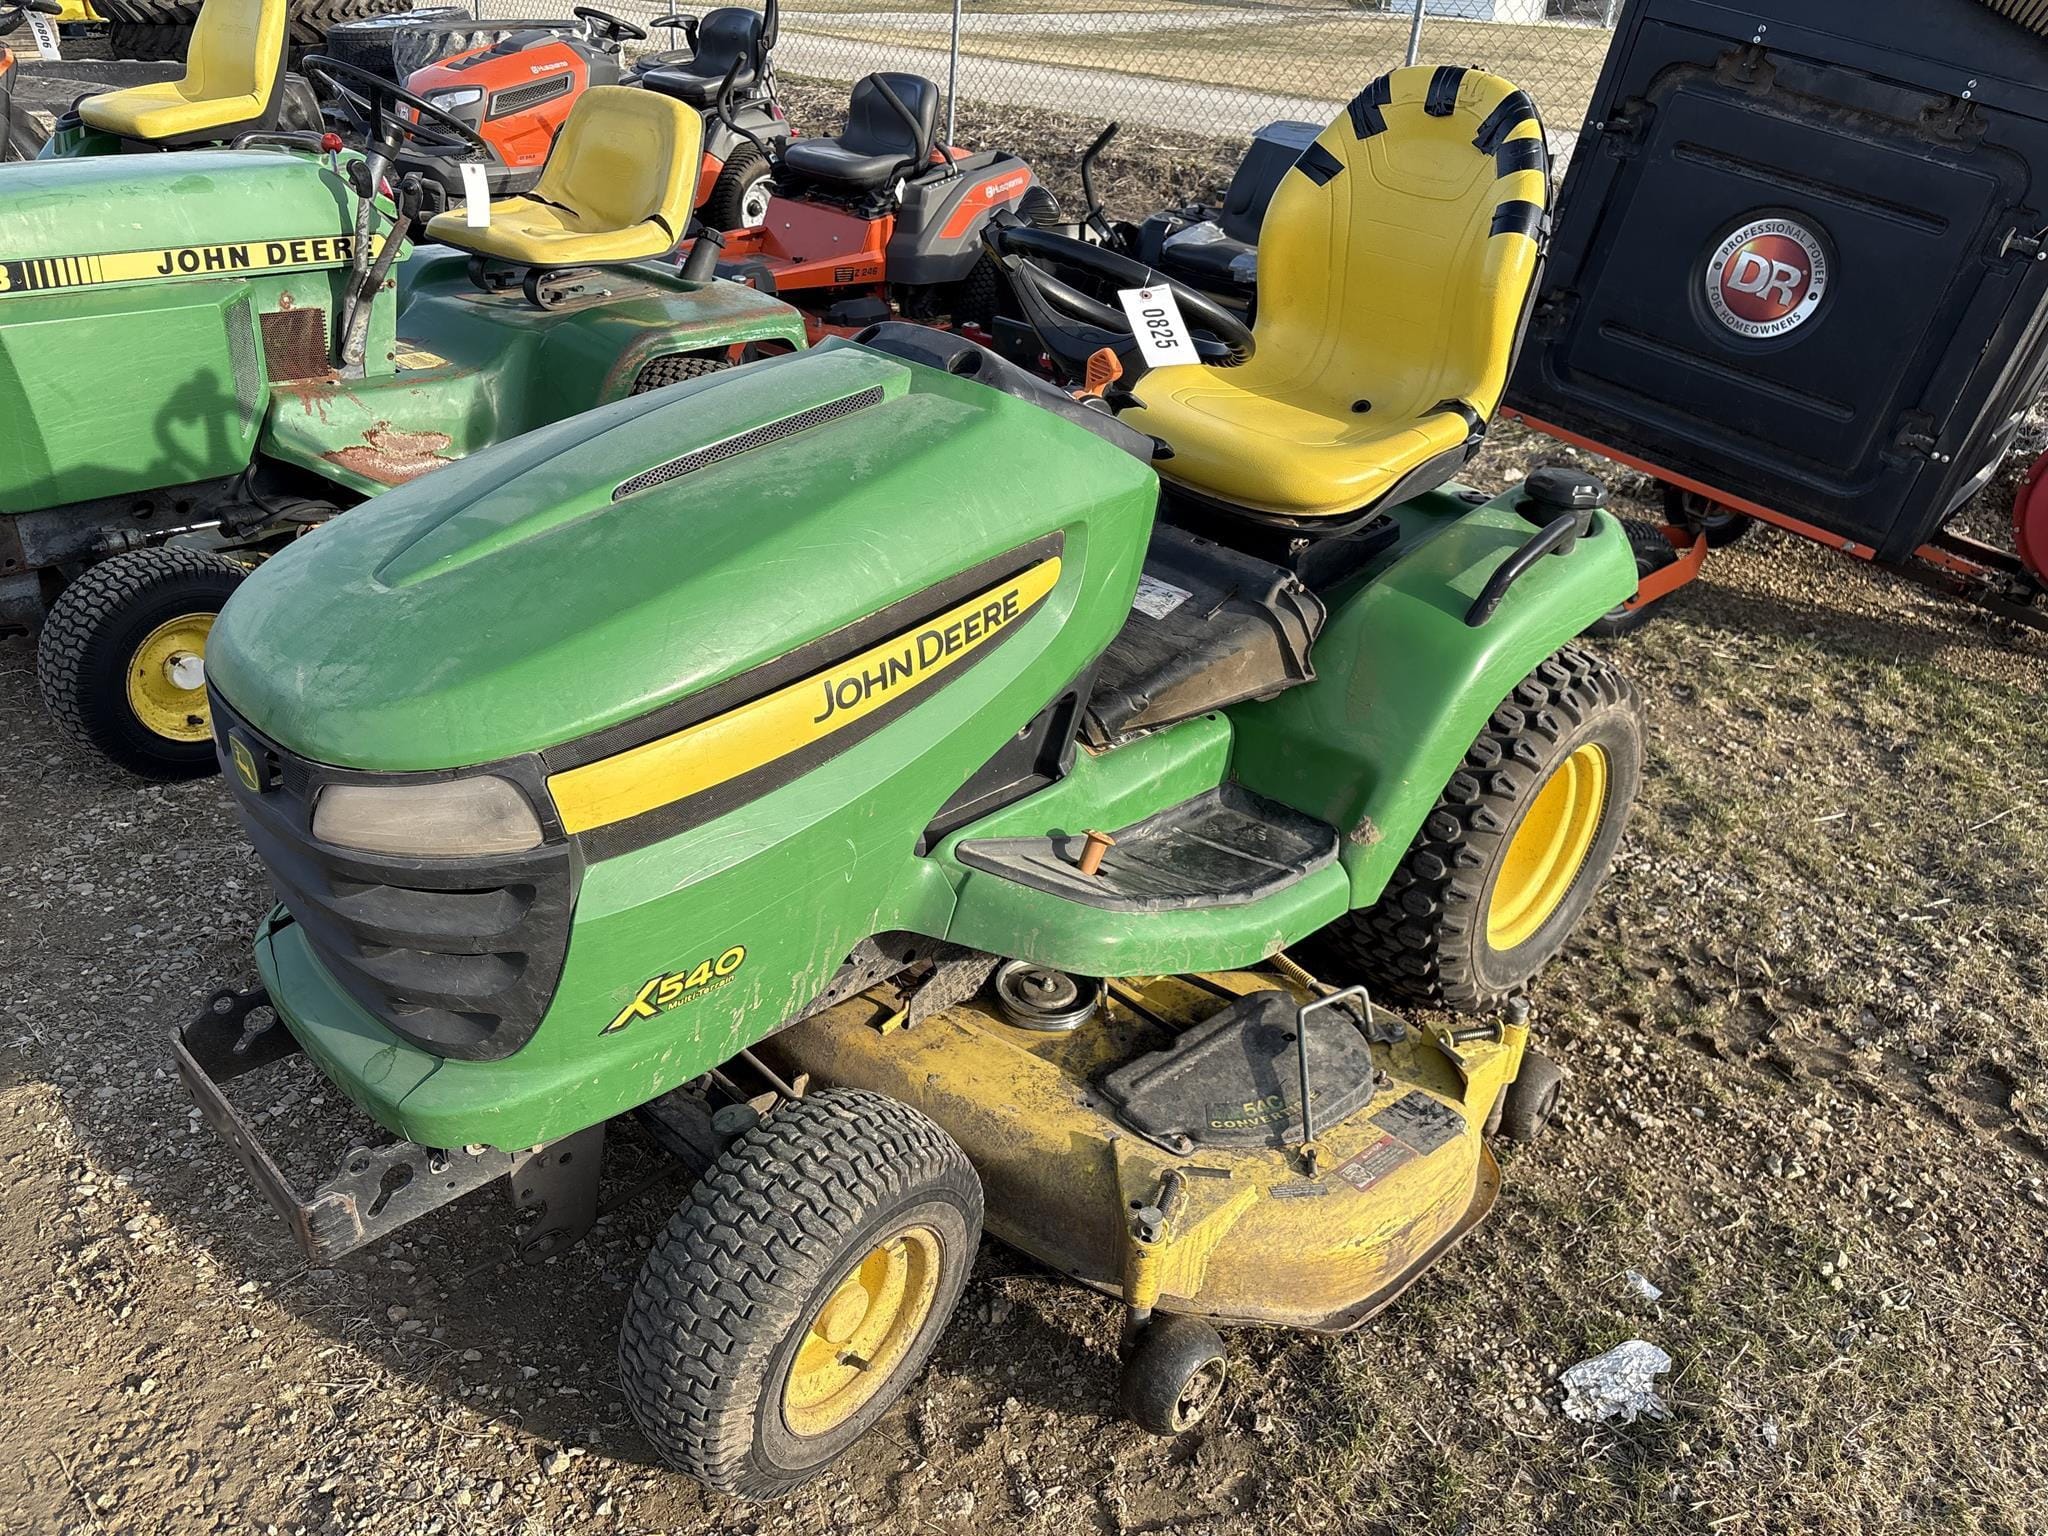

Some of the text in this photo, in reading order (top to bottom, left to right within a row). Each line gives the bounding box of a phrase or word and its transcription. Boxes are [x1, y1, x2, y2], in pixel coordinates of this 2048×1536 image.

[157, 245, 250, 274] JOHN
[1722, 223, 1825, 285] PROFESSIONAL POWER
[1727, 250, 1801, 307] DR
[1142, 308, 1179, 349] 0825
[1710, 286, 1801, 334] FOR HOMEOWNERS
[814, 588, 1020, 724] JOHN DEERE
[598, 944, 748, 1036] X540
